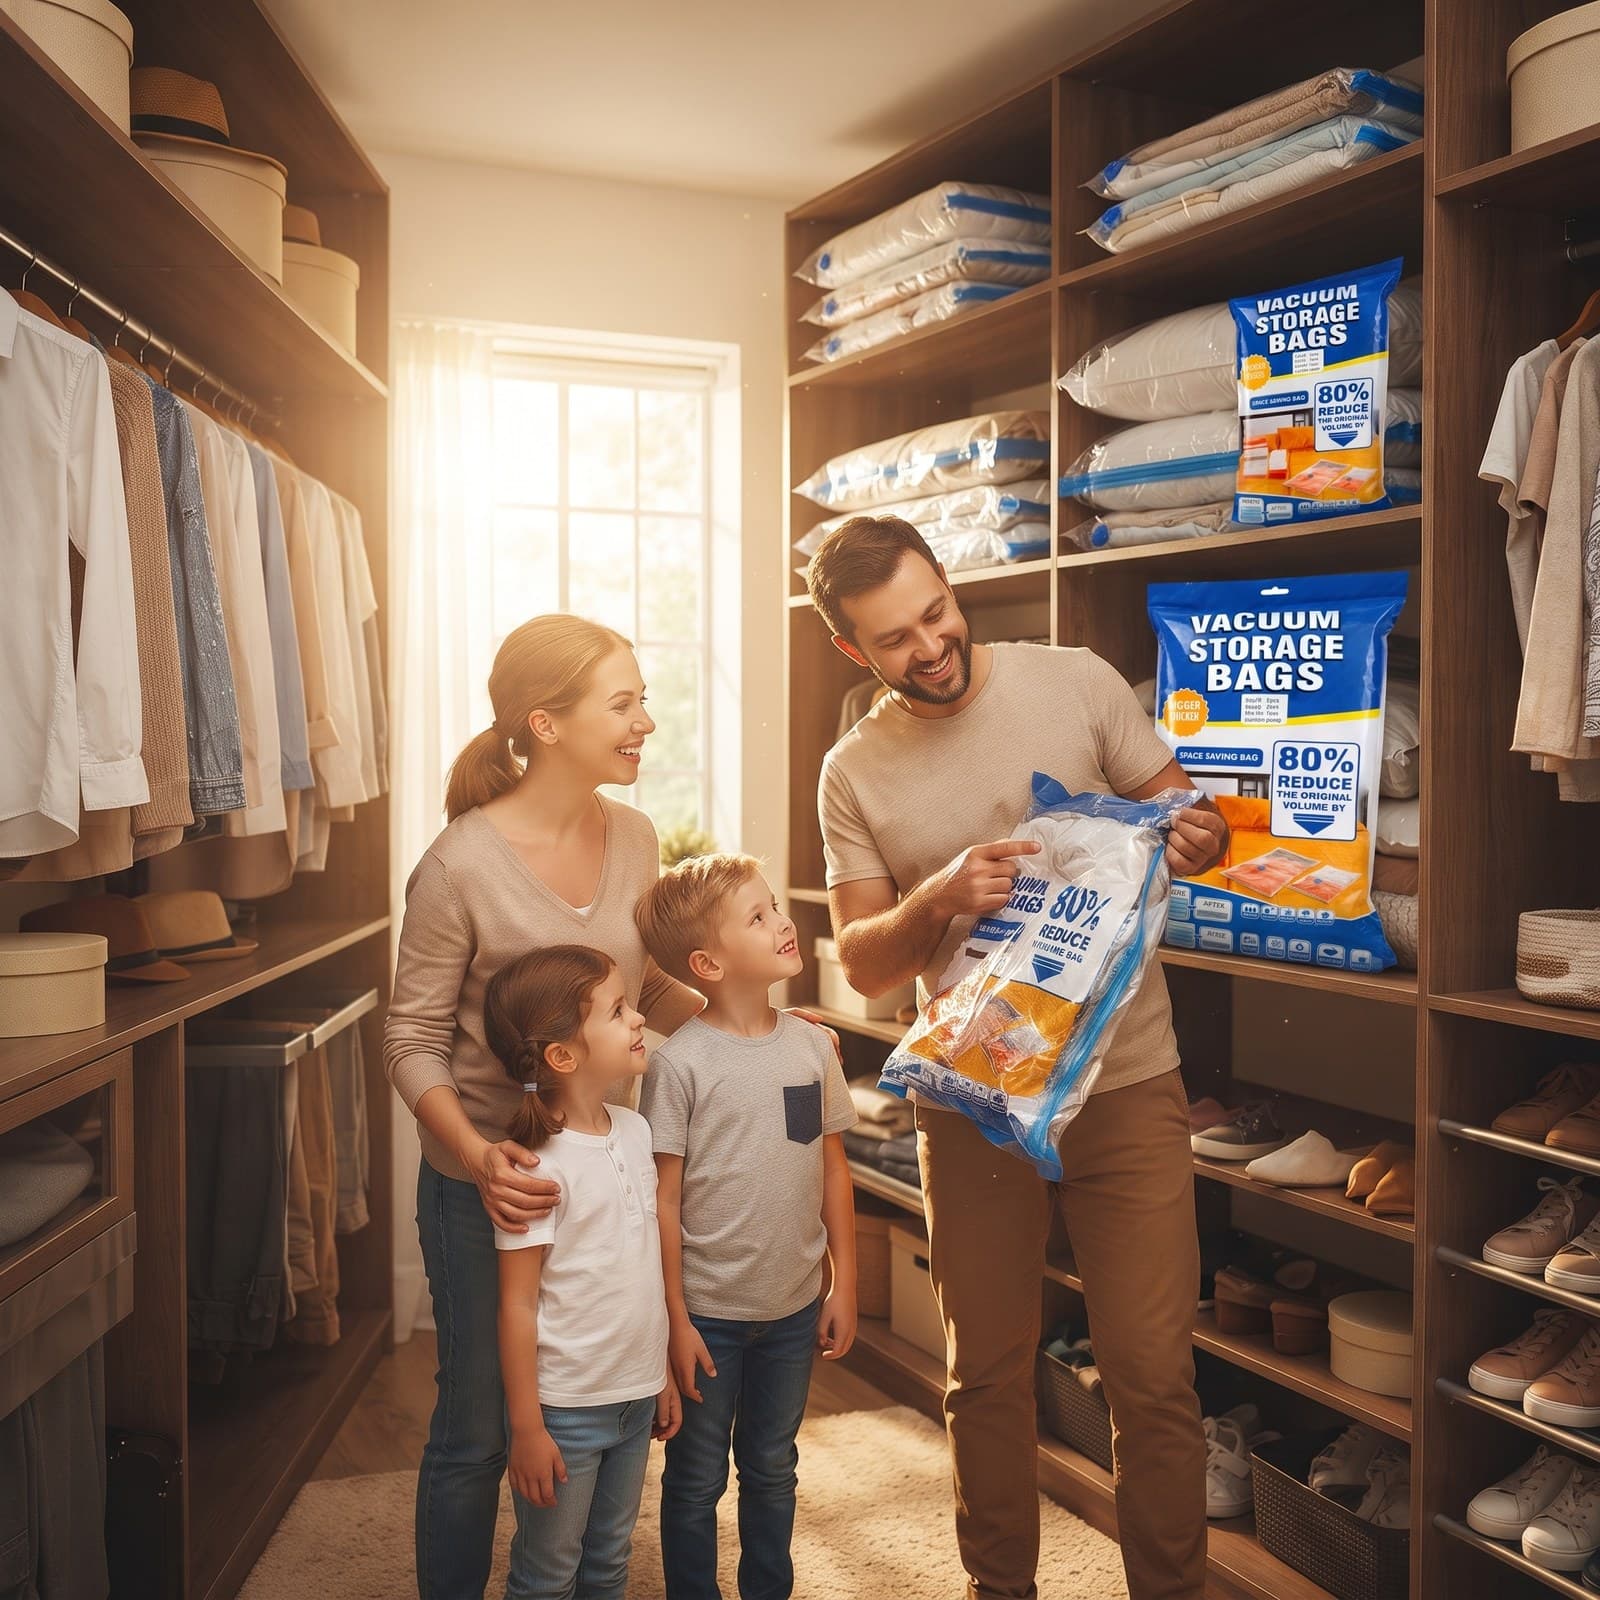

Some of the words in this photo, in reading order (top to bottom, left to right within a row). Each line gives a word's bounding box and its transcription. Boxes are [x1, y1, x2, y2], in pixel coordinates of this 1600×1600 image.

[1256, 284, 1358, 314] VACUUM
[1255, 302, 1360, 335] STORAGE
[1269, 324, 1348, 354] BAGS
[1318, 382, 1369, 404] 80%
[1318, 403, 1369, 416] REDUCE
[1191, 610, 1340, 634] VACUUM
[1189, 634, 1344, 663] STORAGE
[1207, 662, 1324, 692] BAGS
[1179, 751, 1203, 760] SPACE
[1205, 752, 1238, 761] SAVING
[1240, 753, 1259, 762] BAG
[1278, 746, 1354, 773] 80%
[1278, 775, 1352, 790] REDUCE
[1277, 790, 1297, 799] THE
[1300, 791, 1352, 802] ORIGINAL
[1283, 801, 1329, 812] VOLUME
[1331, 803, 1346, 812] BY
[1049, 885, 1112, 931] 80%
[1038, 923, 1091, 951] REDUCE
[1065, 952, 1083, 964] BAG
